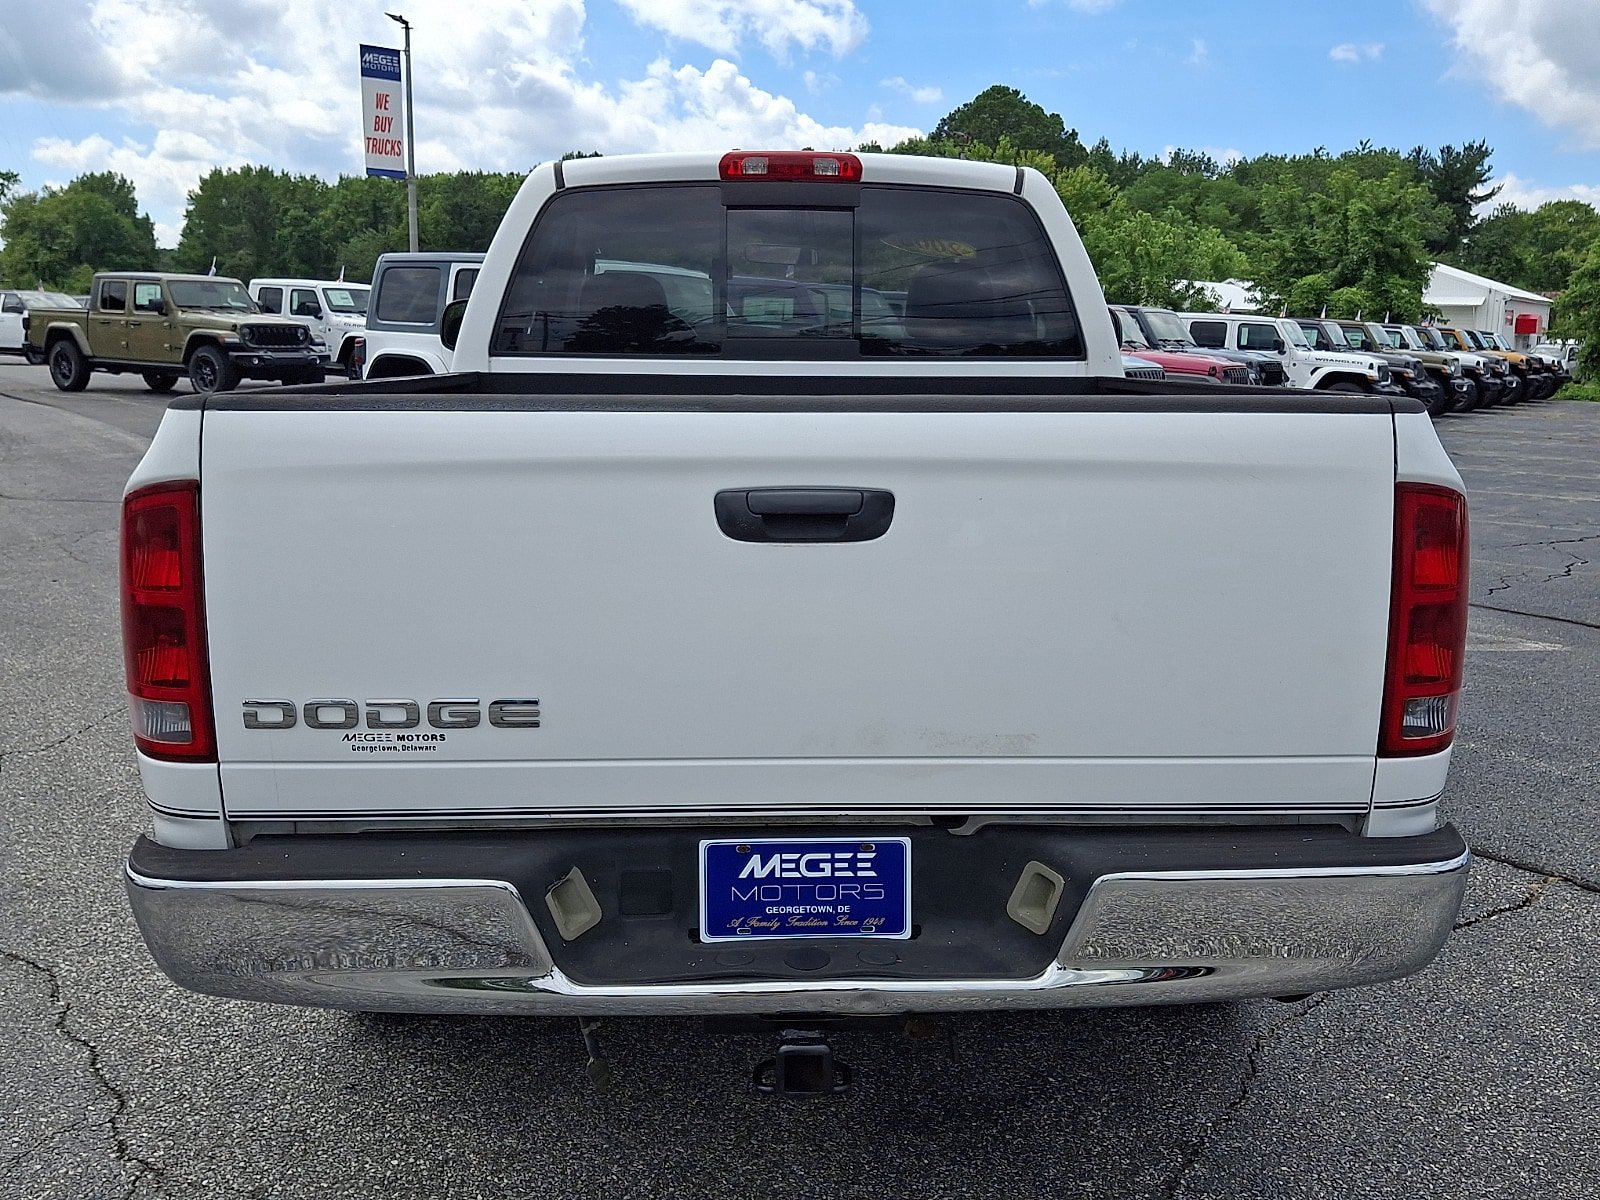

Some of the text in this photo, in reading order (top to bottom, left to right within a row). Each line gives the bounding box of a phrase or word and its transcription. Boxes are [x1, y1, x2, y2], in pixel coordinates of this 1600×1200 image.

[362, 53, 398, 66] MEGEE
[362, 63, 399, 73] MOTORS
[376, 93, 390, 110] WE
[374, 116, 393, 132] BUY
[366, 138, 402, 156] TRUCKS
[1315, 357, 1363, 365] WRANGLER
[242, 698, 540, 729] DODGE
[341, 733, 446, 741] MEGEE MOTORS
[351, 745, 400, 753] Georgetown,
[739, 853, 877, 879] MEGEE
[732, 884, 884, 901] MOTORS
[766, 906, 835, 914] GEORGETOWN,
[727, 917, 743, 928] A
[745, 917, 780, 930] Family
[786, 916, 828, 927] Tradition
[834, 915, 858, 926] Since
